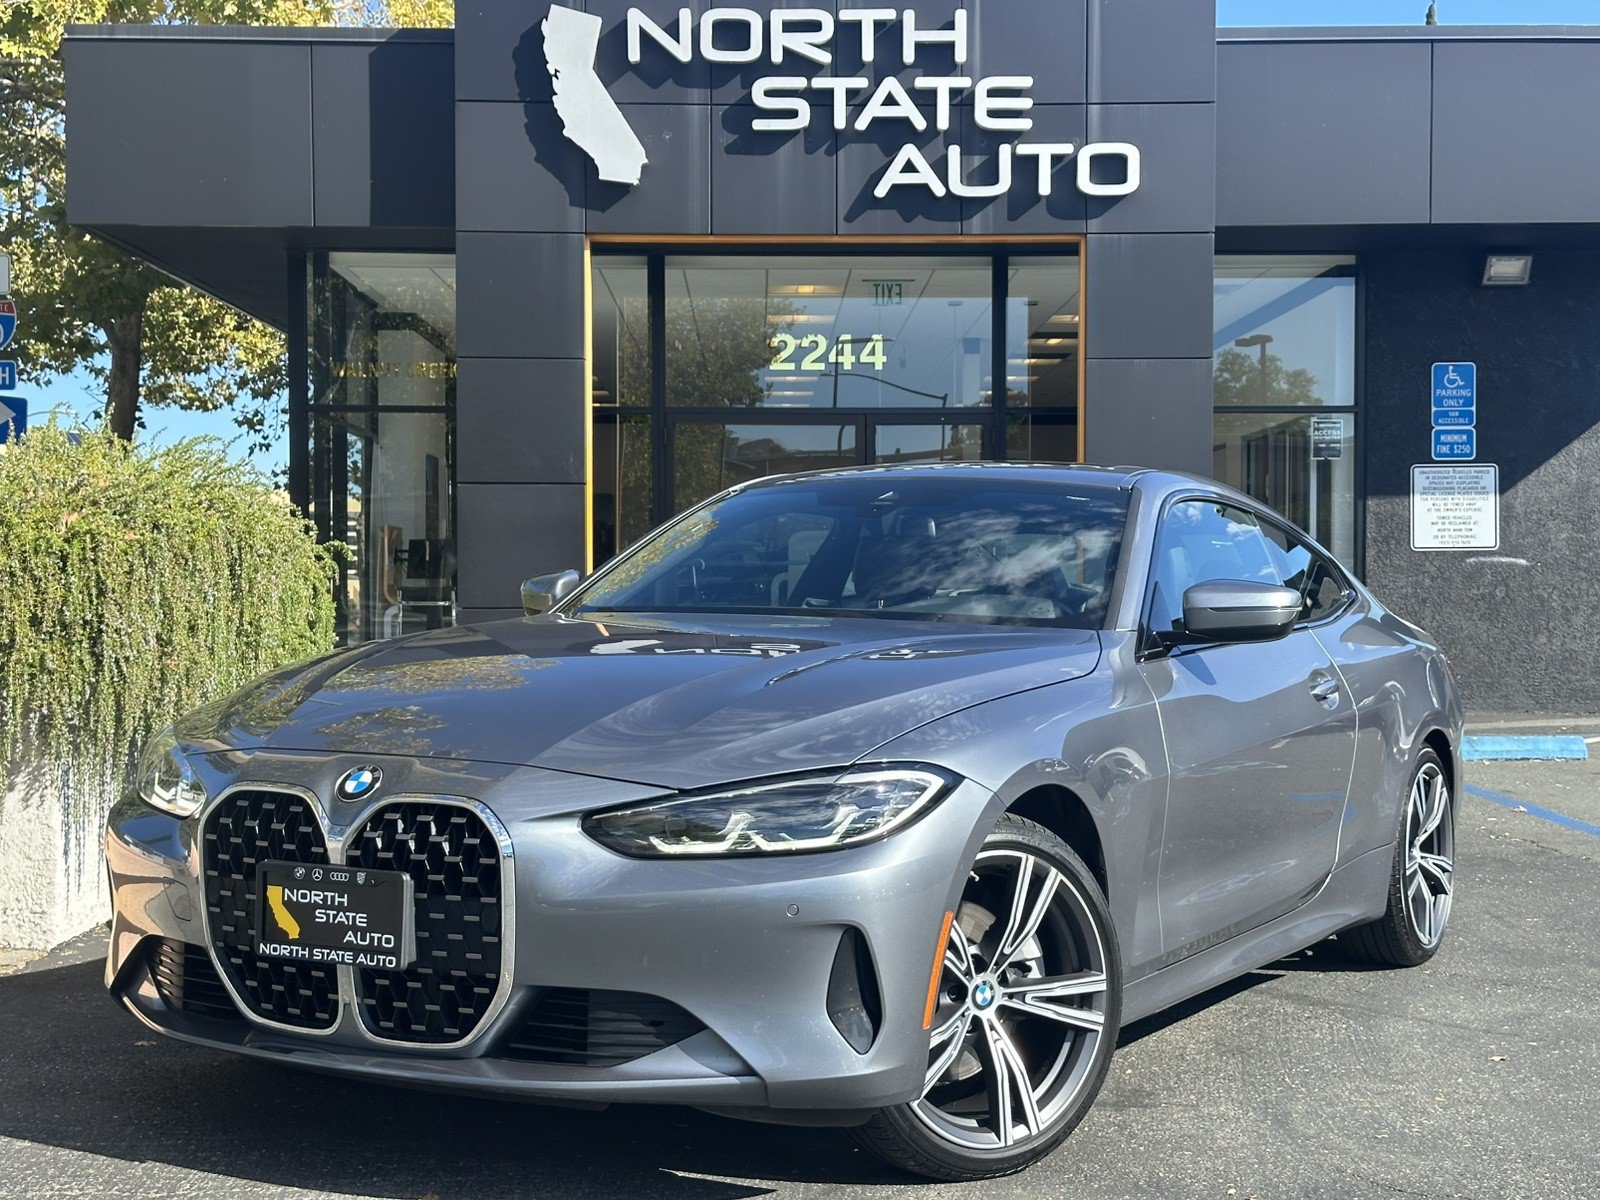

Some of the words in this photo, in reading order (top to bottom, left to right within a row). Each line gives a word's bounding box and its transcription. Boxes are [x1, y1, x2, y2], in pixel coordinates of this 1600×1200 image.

[627, 7, 968, 65] NORTH
[751, 76, 1034, 131] STATE
[873, 142, 1141, 199] AUTO
[769, 333, 887, 371] 2244
[1436, 389, 1472, 397] PARKING
[1443, 398, 1464, 407] ONLY
[1440, 434, 1467, 443] MINIMUM
[1436, 445, 1451, 454] FINE
[1453, 444, 1471, 454] $250
[284, 888, 348, 907] NORTH
[315, 909, 368, 927] STATE
[343, 930, 395, 948] AUTO
[259, 942, 309, 959] NORTH
[312, 948, 354, 964] STATE
[356, 953, 396, 968] AUTO
